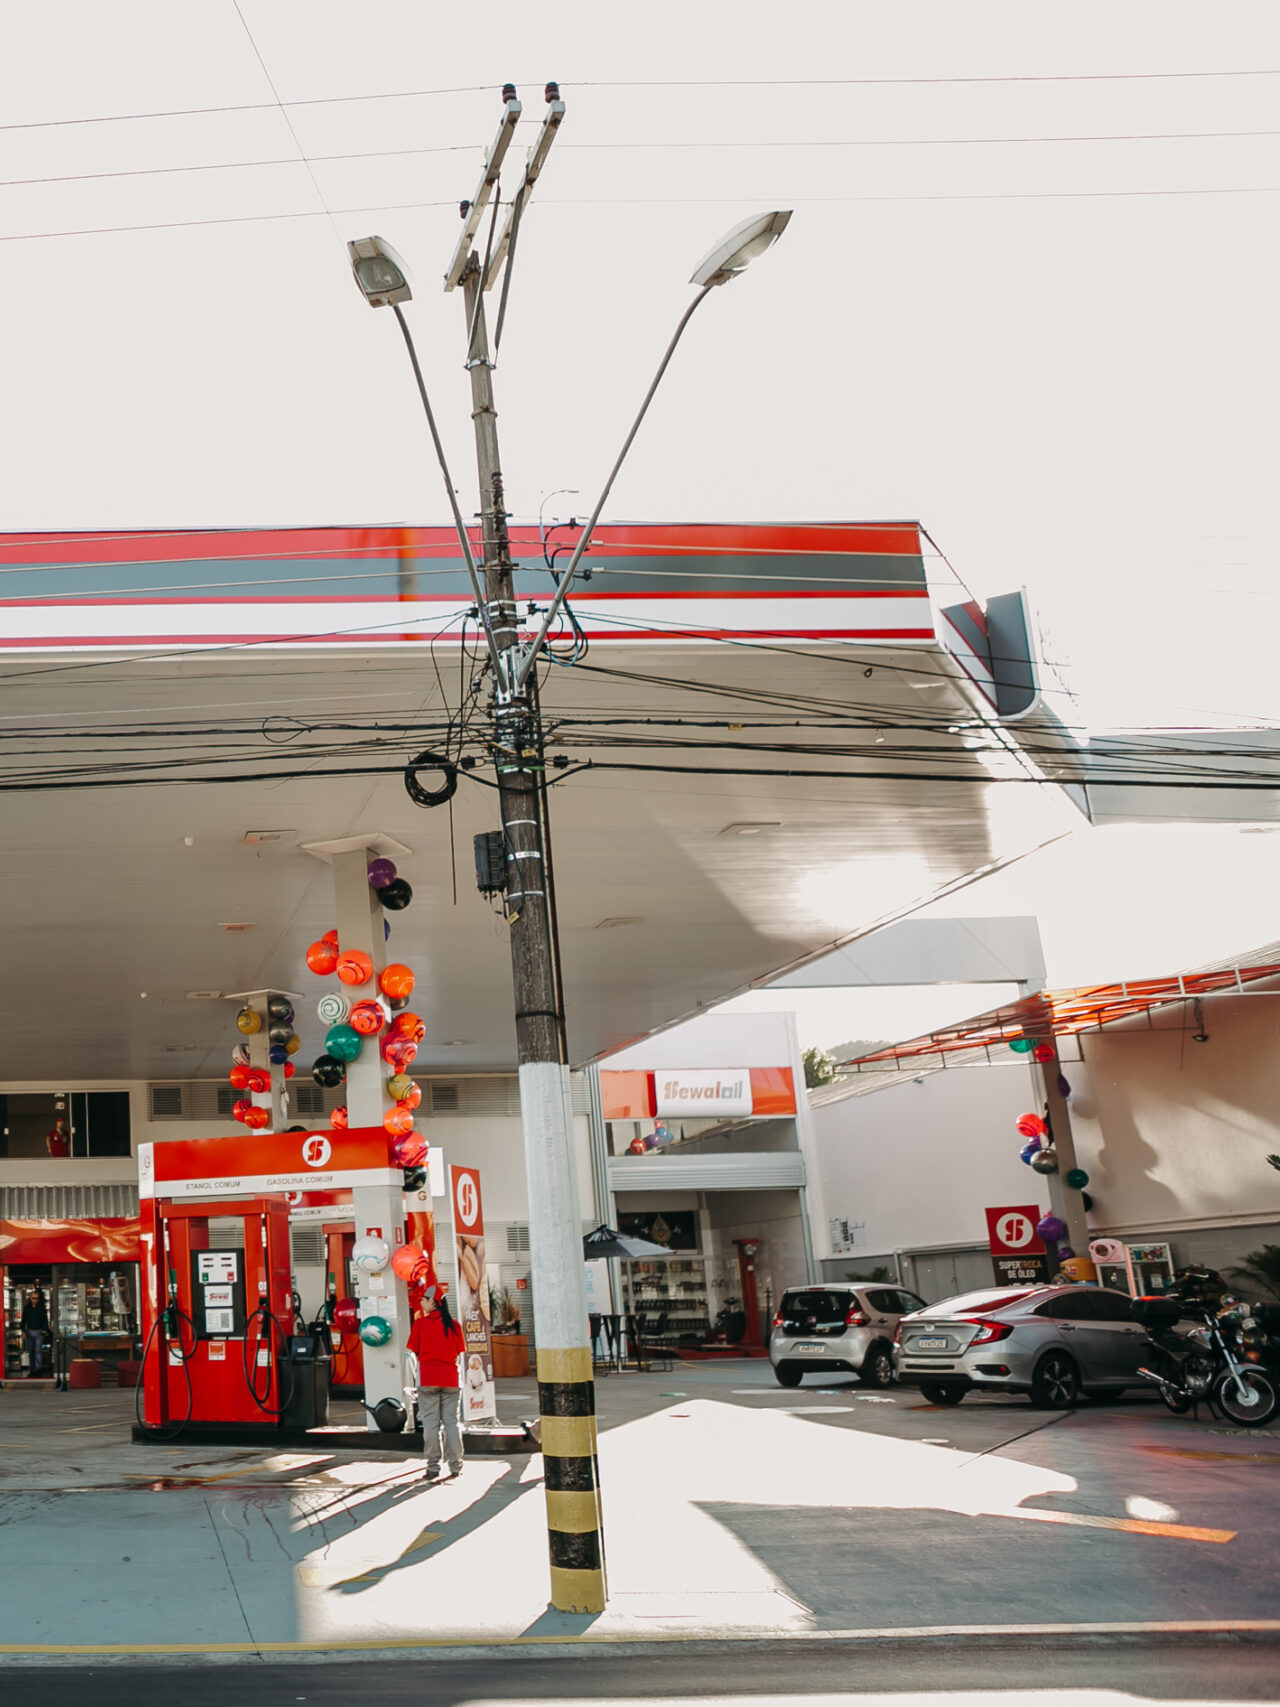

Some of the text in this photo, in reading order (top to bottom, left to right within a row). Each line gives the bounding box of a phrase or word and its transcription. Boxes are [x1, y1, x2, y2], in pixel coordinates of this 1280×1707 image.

[186, 1180, 240, 1190] ETANOL COMUM
[267, 1175, 333, 1186] GASOLINA COMUM
